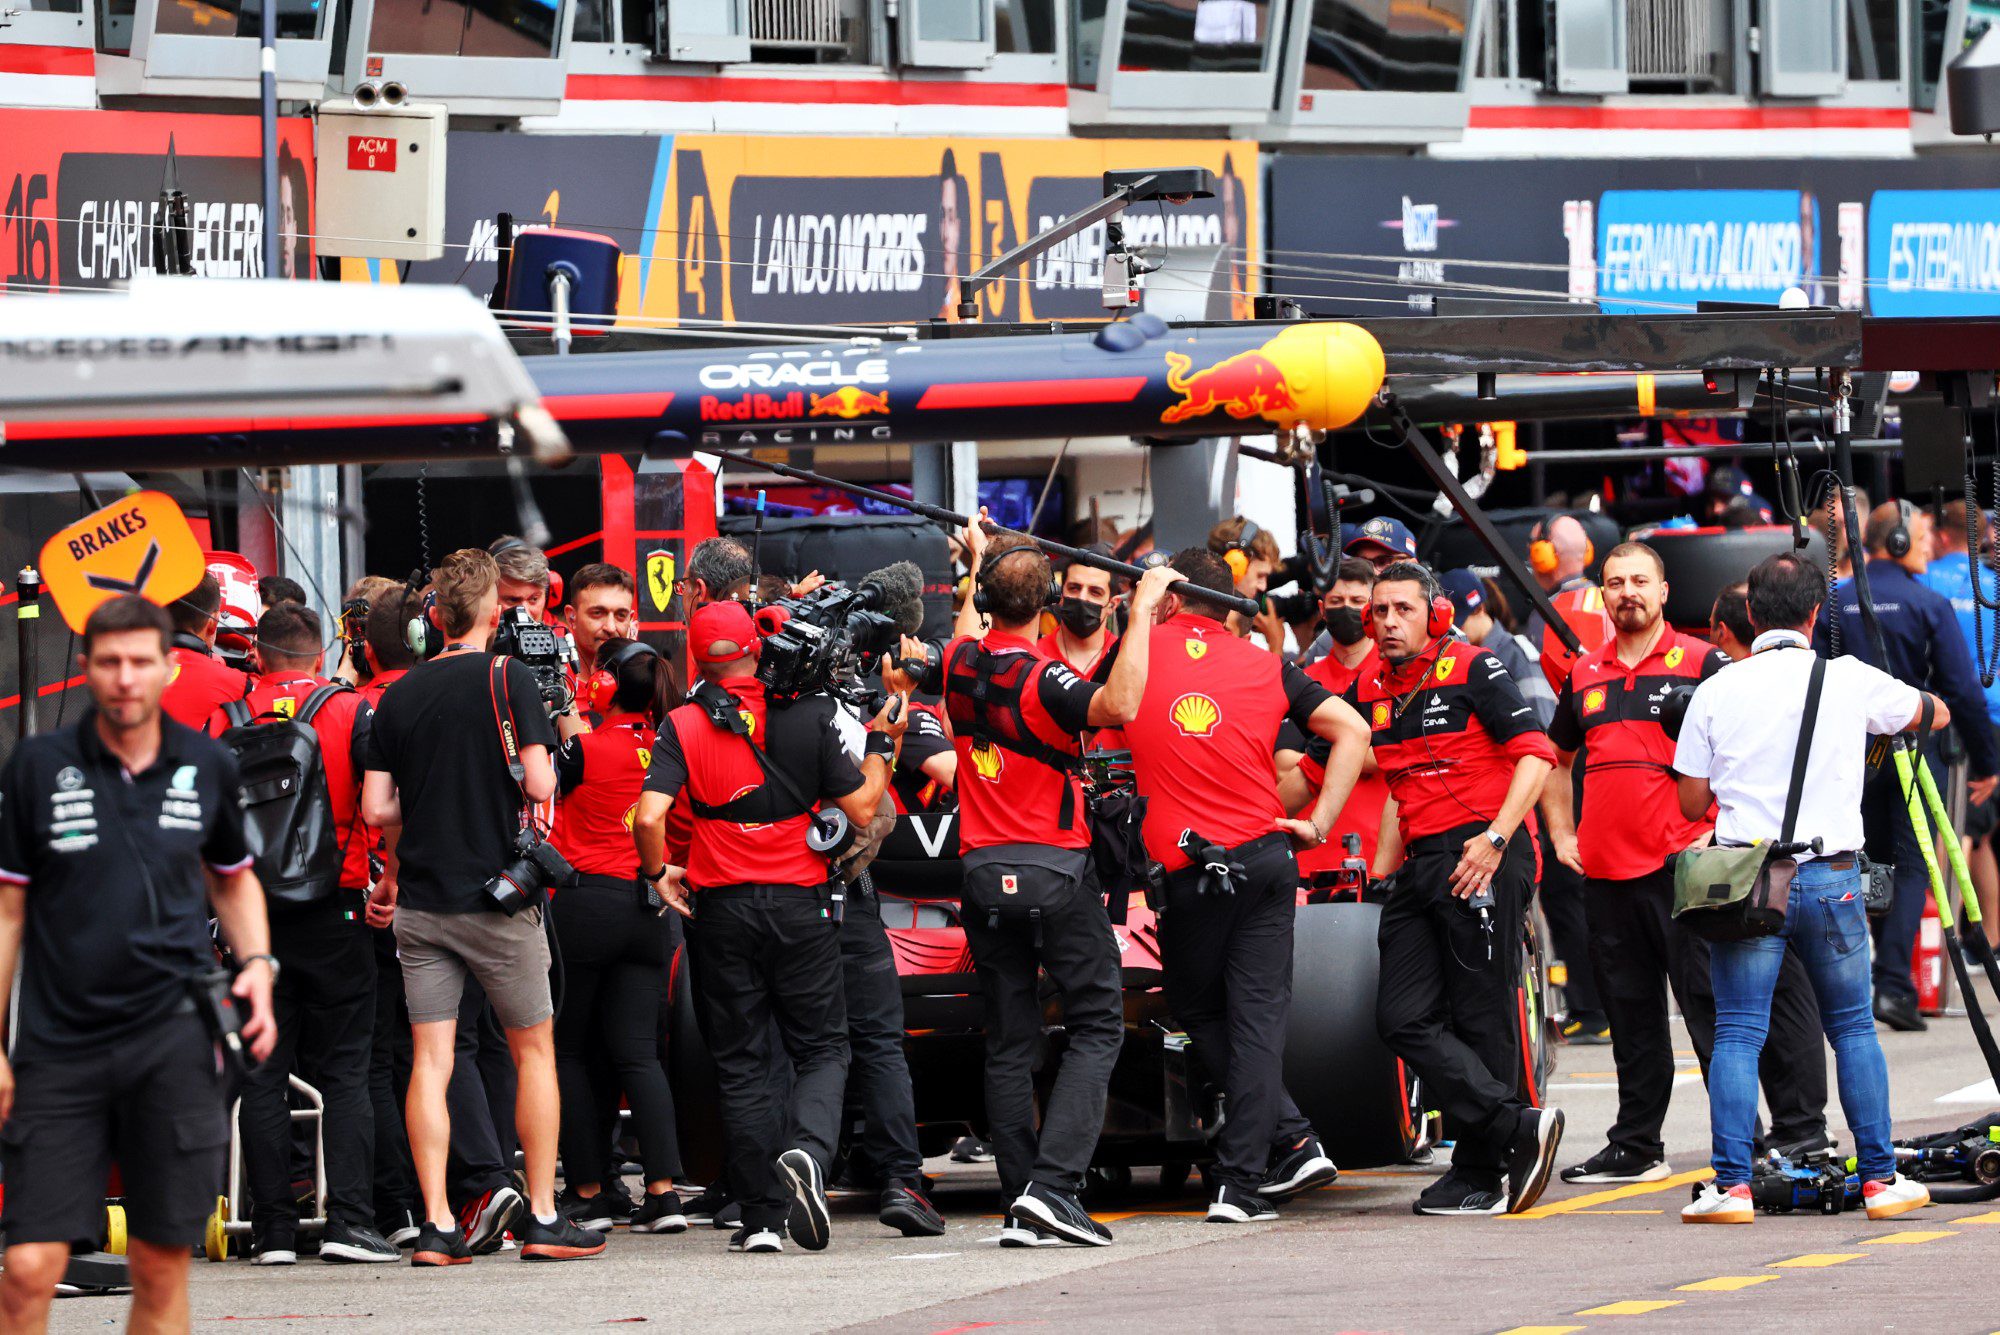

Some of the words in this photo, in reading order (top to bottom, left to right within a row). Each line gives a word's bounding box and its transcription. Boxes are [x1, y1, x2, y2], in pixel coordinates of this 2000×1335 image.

[357, 138, 388, 153] ACM
[5, 173, 50, 291] 16
[77, 200, 168, 279] CHARL
[188, 202, 264, 279] ECLER
[685, 196, 706, 315] 4
[752, 214, 836, 294] LANDO
[835, 213, 928, 294] NORRIS
[1036, 215, 1106, 290] DANIE
[1603, 221, 1720, 292] FERNANDO
[1716, 221, 1800, 290] ALONSO
[1888, 222, 1979, 292] ESTEBAN
[699, 359, 890, 389] ORACLE
[700, 393, 752, 421] Red
[752, 391, 804, 419] Bull
[702, 426, 892, 445] RACING
[67, 507, 147, 561] BRAKES
[502, 720, 516, 757] Canon
[1424, 704, 1450, 715] antander
